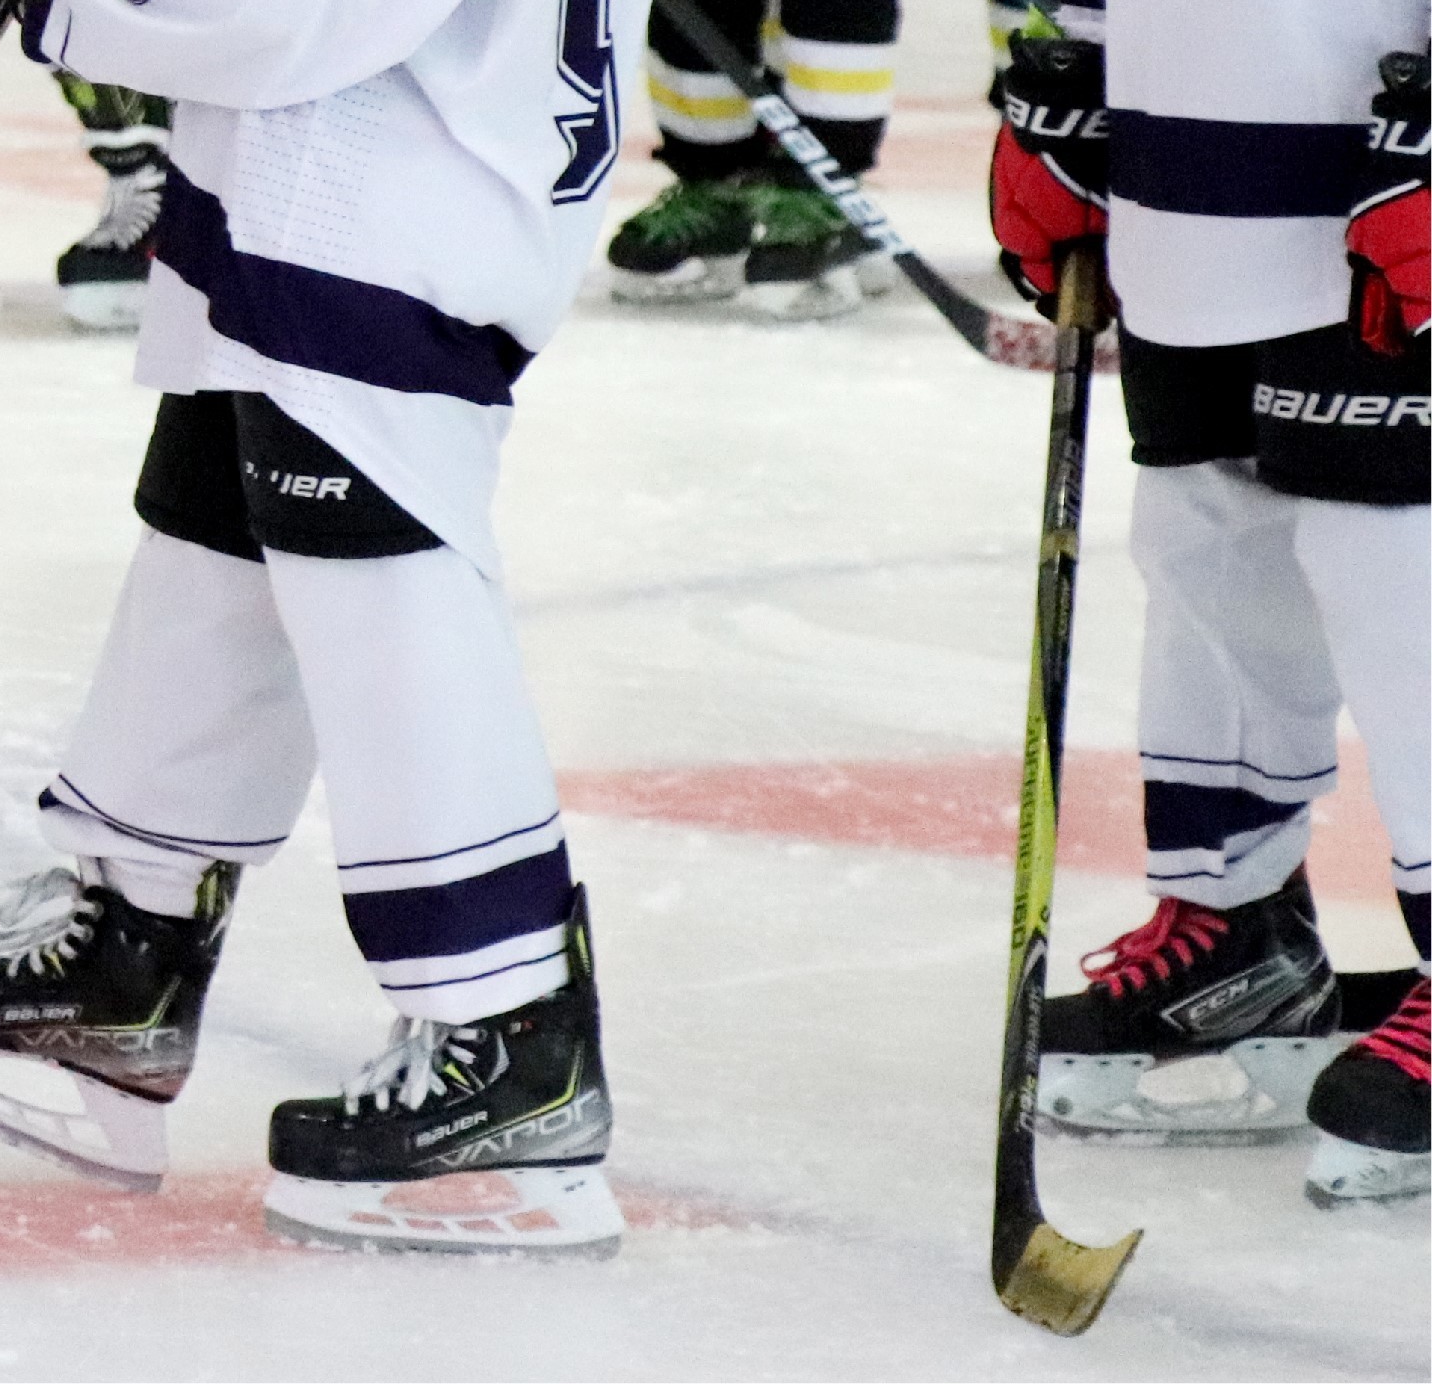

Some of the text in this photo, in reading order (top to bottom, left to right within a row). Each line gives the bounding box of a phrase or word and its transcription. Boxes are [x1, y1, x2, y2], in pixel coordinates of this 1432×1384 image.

[1004, 96, 1110, 140] AUE
[753, 93, 917, 256] BAUER
[1252, 383, 1432, 427] BAUER
[415, 1110, 489, 1148] BAUER
